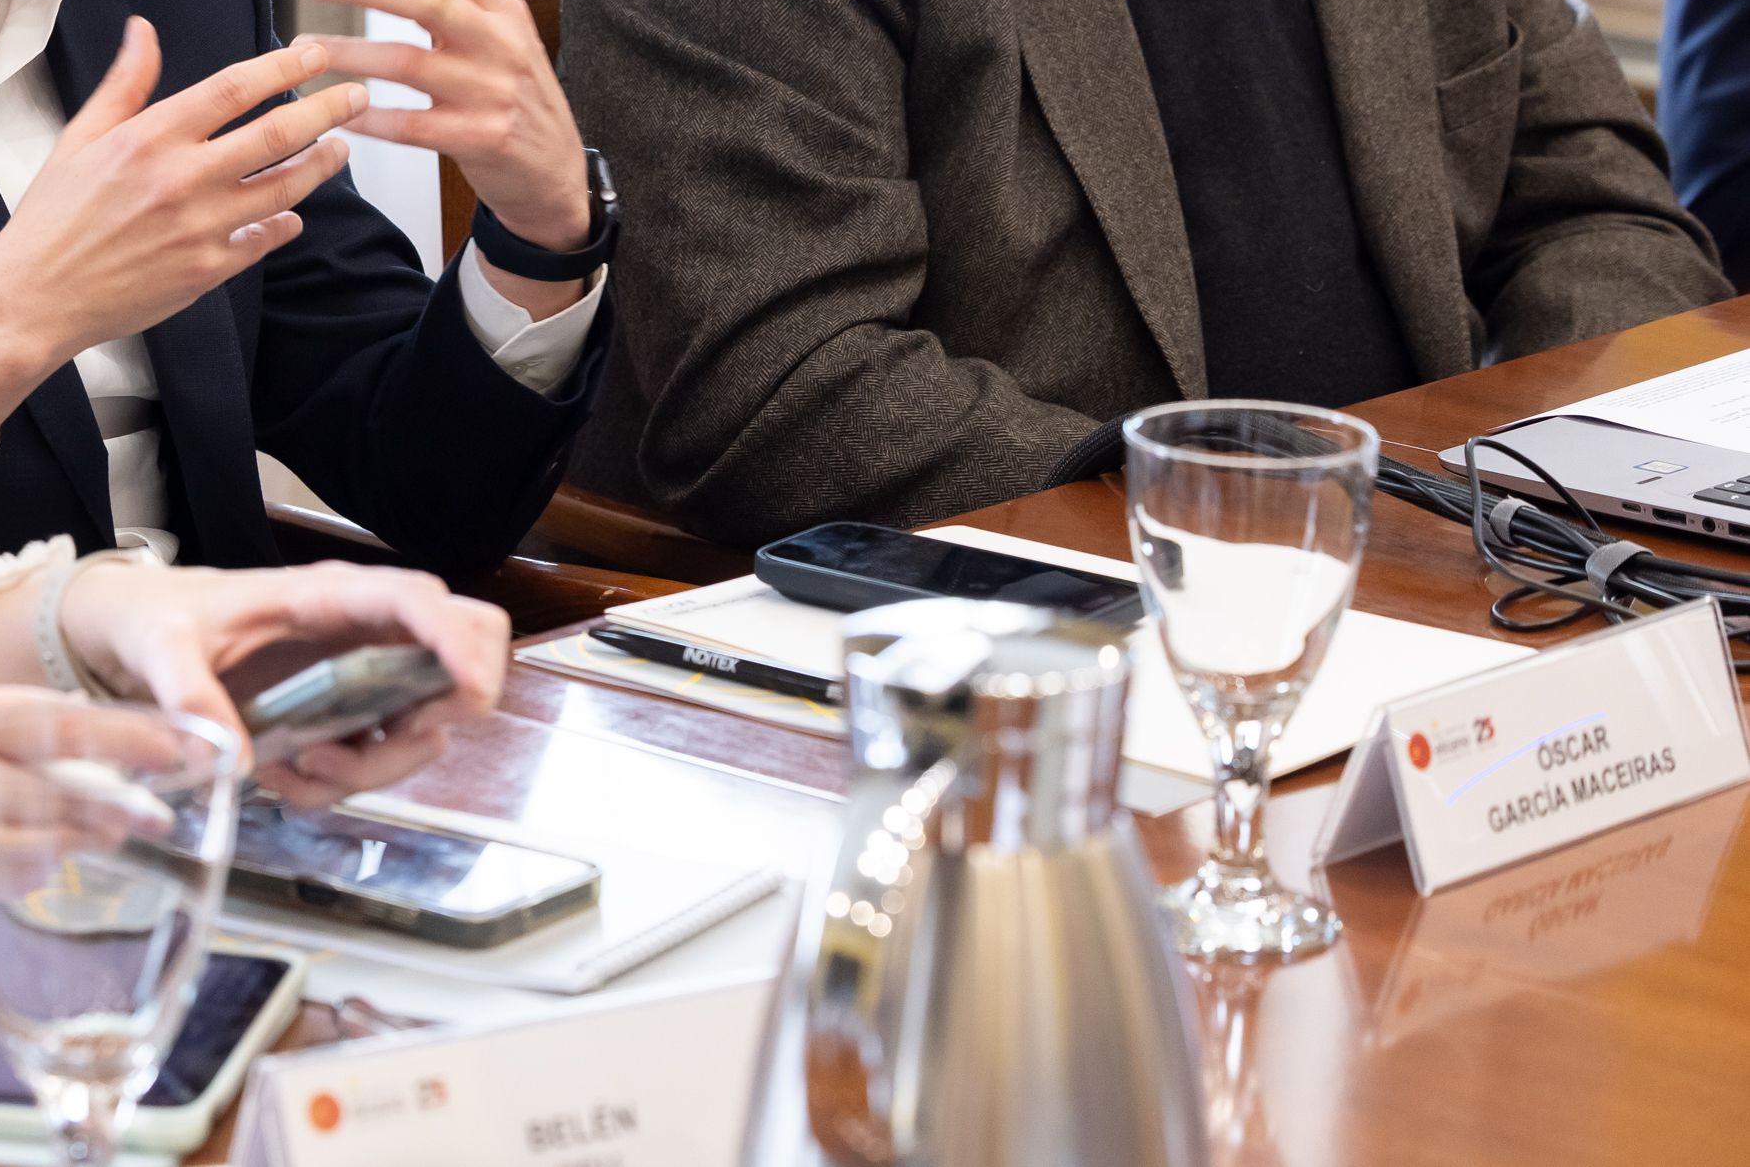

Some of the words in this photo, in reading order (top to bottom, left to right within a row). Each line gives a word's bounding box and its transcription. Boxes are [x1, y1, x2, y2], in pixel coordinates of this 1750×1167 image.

[682, 645, 740, 674] INDITEX
[1537, 724, 1610, 772] ÓSCAR
[1488, 780, 1569, 833] GARCÍA
[1571, 746, 1677, 804] MACEIRAS
